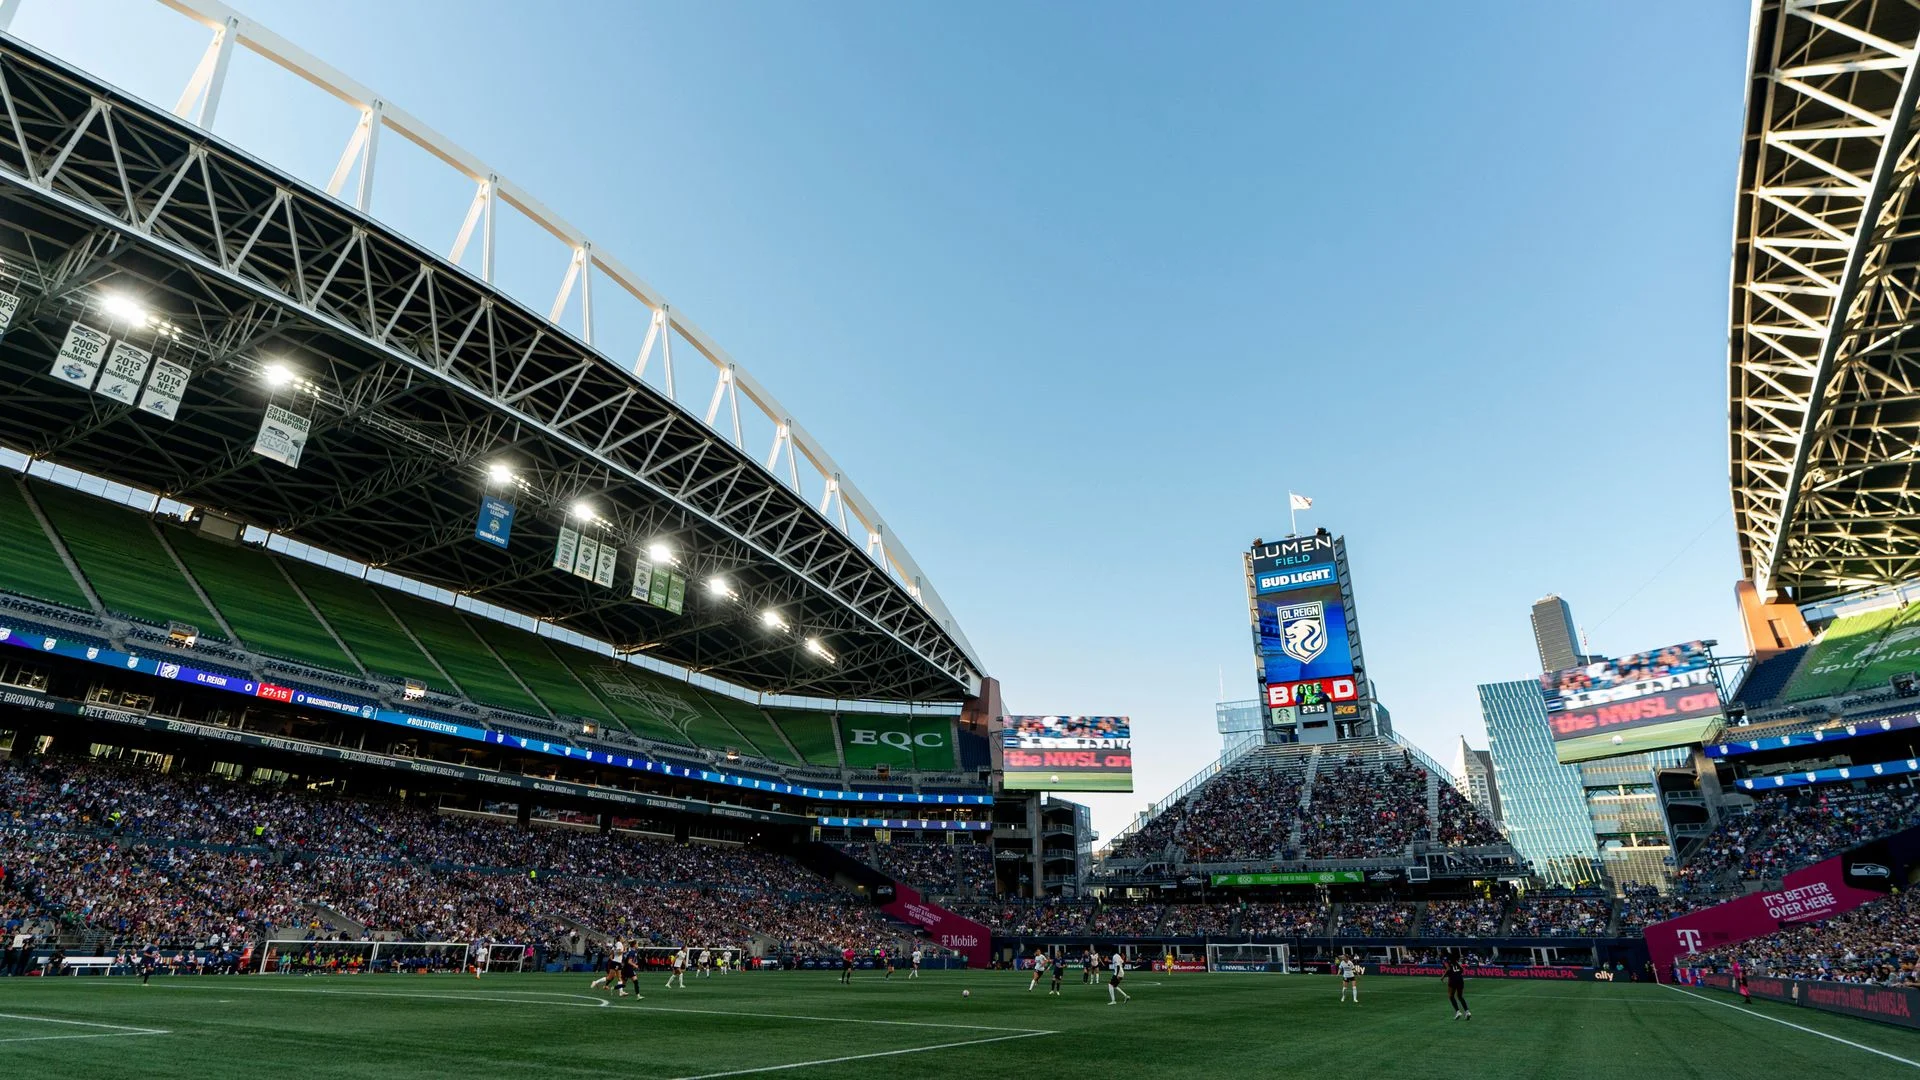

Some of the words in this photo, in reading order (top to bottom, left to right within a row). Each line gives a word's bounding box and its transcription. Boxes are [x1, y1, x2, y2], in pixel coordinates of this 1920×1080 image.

[72, 336, 100, 354] 2005
[73, 346, 92, 360] NFC
[60, 350, 98, 369] CHAMPIONS
[115, 354, 142, 372] 2013
[104, 368, 140, 386] CHAMPIONS
[116, 364, 135, 377] NFC
[156, 371, 182, 387] 2014
[146, 385, 181, 402] CHAMPIONS
[157, 381, 176, 394] NFC
[266, 412, 308, 432] CHAMPIONS
[268, 406, 286, 418] 2013
[288, 412, 310, 426] WORLD
[1252, 536, 1332, 560] LUMEN
[1275, 554, 1310, 567] FIELD
[1261, 572, 1290, 588] BUD
[1291, 568, 1331, 584] LIGHT
[1282, 608, 1293, 619] OL
[1294, 606, 1319, 618] REIGN
[197, 673, 206, 682] OL
[207, 675, 227, 686] REIGN
[245, 683, 252, 692] 0
[4, 692, 37, 706] BROWN
[263, 687, 288, 699] 27:15
[1270, 680, 1355, 705] BOD
[306, 697, 341, 710] WASHINGTON
[342, 703, 359, 713] SPIRIT
[84, 708, 103, 718] PETE
[104, 711, 131, 722] GROSS
[130, 716, 147, 725] 76-92
[1556, 712, 1598, 733] the
[1597, 697, 1676, 726] NWSL
[167, 722, 180, 731] 28
[180, 724, 197, 734] CURT
[198, 726, 227, 739] WARNER
[407, 718, 457, 734] #BOLDTOGETHER
[269, 741, 285, 749] PAUL
[292, 744, 310, 753] ALLEN
[850, 728, 943, 752] EQC
[339, 751, 349, 759] 79
[349, 753, 366, 762] JACOB
[366, 755, 384, 765] GREEN
[1010, 750, 1042, 766] the
[1044, 752, 1102, 767] NWSL
[411, 762, 420, 771] 45
[420, 764, 437, 774] KENNY
[437, 766, 454, 776] EASLEY
[1762, 893, 1785, 907] IT'S
[1784, 882, 1830, 901] BETTER
[1769, 902, 1803, 918] OVER
[1802, 893, 1837, 910] HERE
[951, 935, 978, 947] Mobile
[1380, 965, 1407, 974] Proud
[1477, 968, 1507, 977] NWSL
[1509, 969, 1528, 977] and
[1530, 969, 1578, 978] NWSLPA.
[1595, 970, 1614, 981] ally
